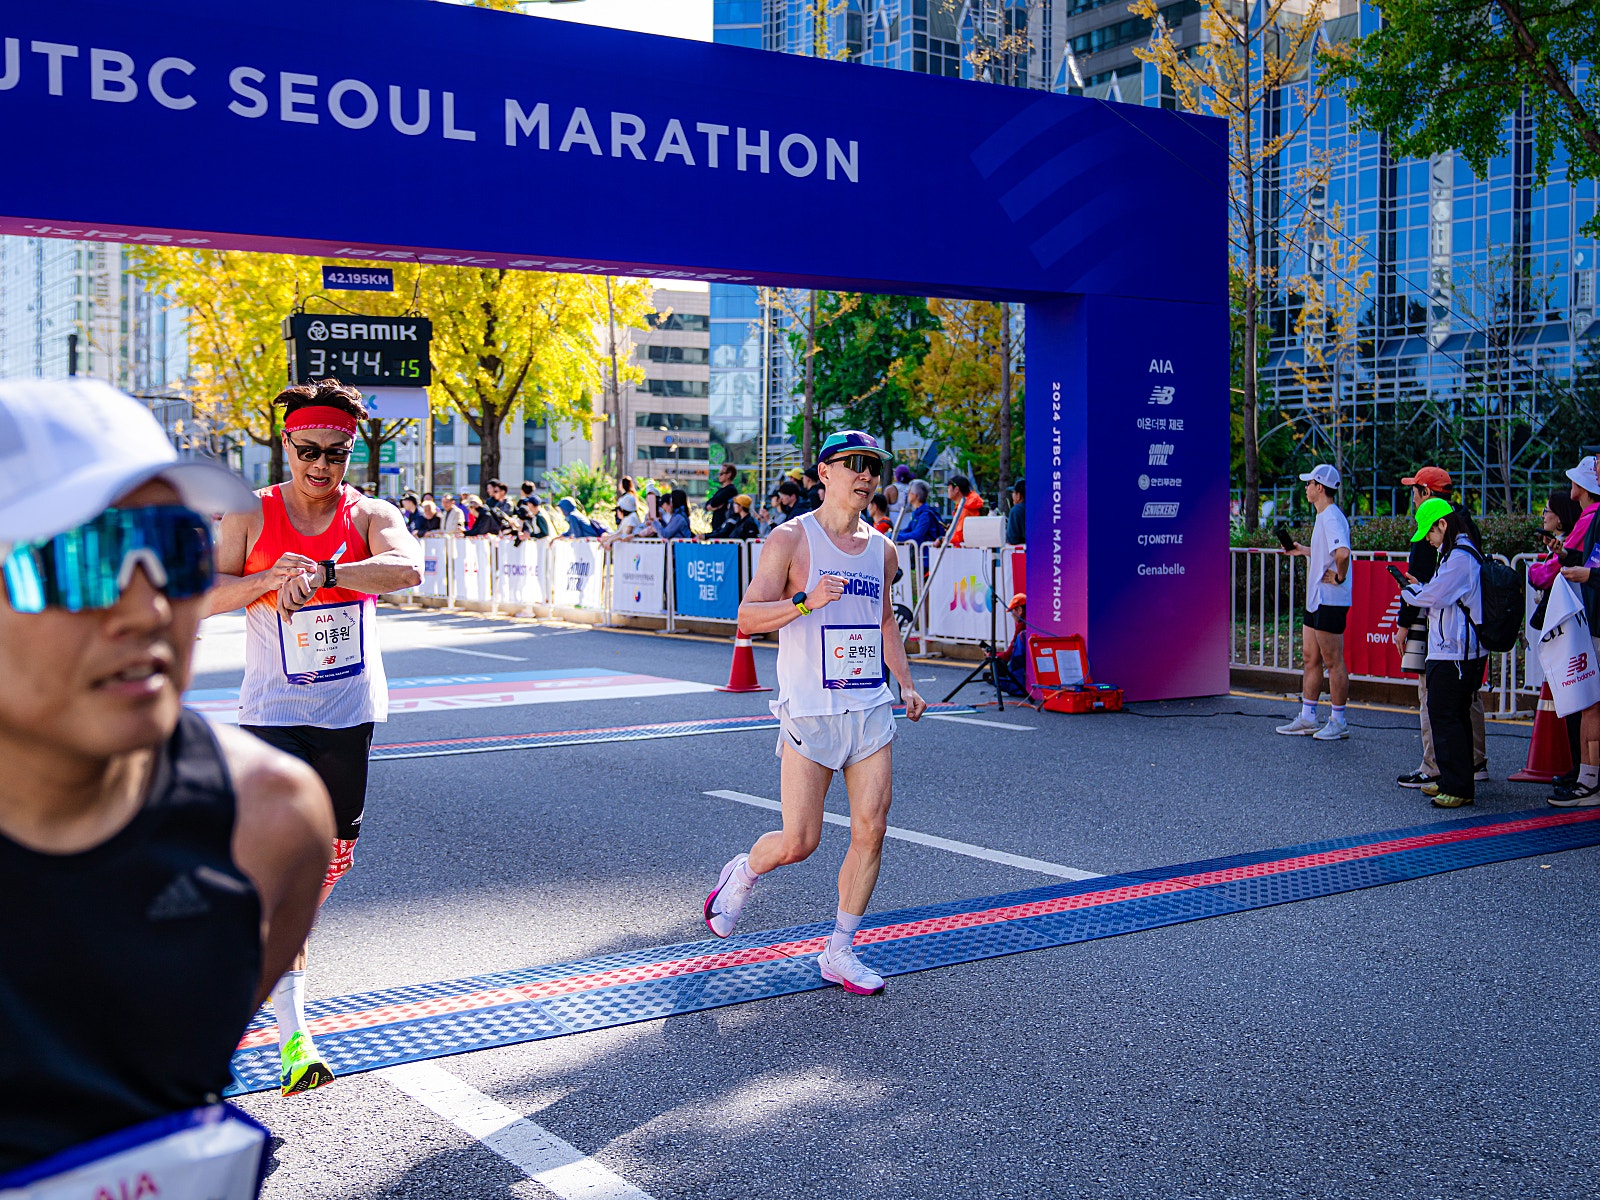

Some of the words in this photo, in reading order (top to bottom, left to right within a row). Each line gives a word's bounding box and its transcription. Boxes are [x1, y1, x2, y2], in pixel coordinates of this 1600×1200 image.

[0, 37, 198, 111] JTBC
[227, 66, 476, 142] SEOUL
[504, 98, 859, 183] MARATHON
[327, 272, 390, 286] 42.195KM
[330, 323, 418, 341] SAMIK
[1148, 358, 1174, 374] AIA
[1052, 382, 1061, 422] 2024
[1136, 417, 1167, 430] 이온더핏
[1168, 418, 1184, 431] 제로
[1052, 426, 1061, 467] JTBC
[1148, 441, 1175, 455] amino
[1148, 454, 1168, 466] VITAL
[1052, 471, 1062, 524] SEOUL
[1144, 504, 1177, 516] SNICKERS
[687, 560, 725, 582] 이온더핏
[842, 570, 859, 578] Your
[1052, 529, 1062, 622] MARATHON
[1137, 563, 1185, 576] Genabelle
[843, 578, 880, 600] NCARE
[315, 614, 335, 624] AIA
[296, 632, 310, 648] E
[314, 625, 350, 645] 이종원
[848, 633, 863, 641] AIA
[1366, 632, 1390, 644] new
[833, 646, 845, 659] C
[848, 645, 876, 659] 문학진
[1561, 677, 1577, 688] new
[1576, 669, 1596, 682] balance
